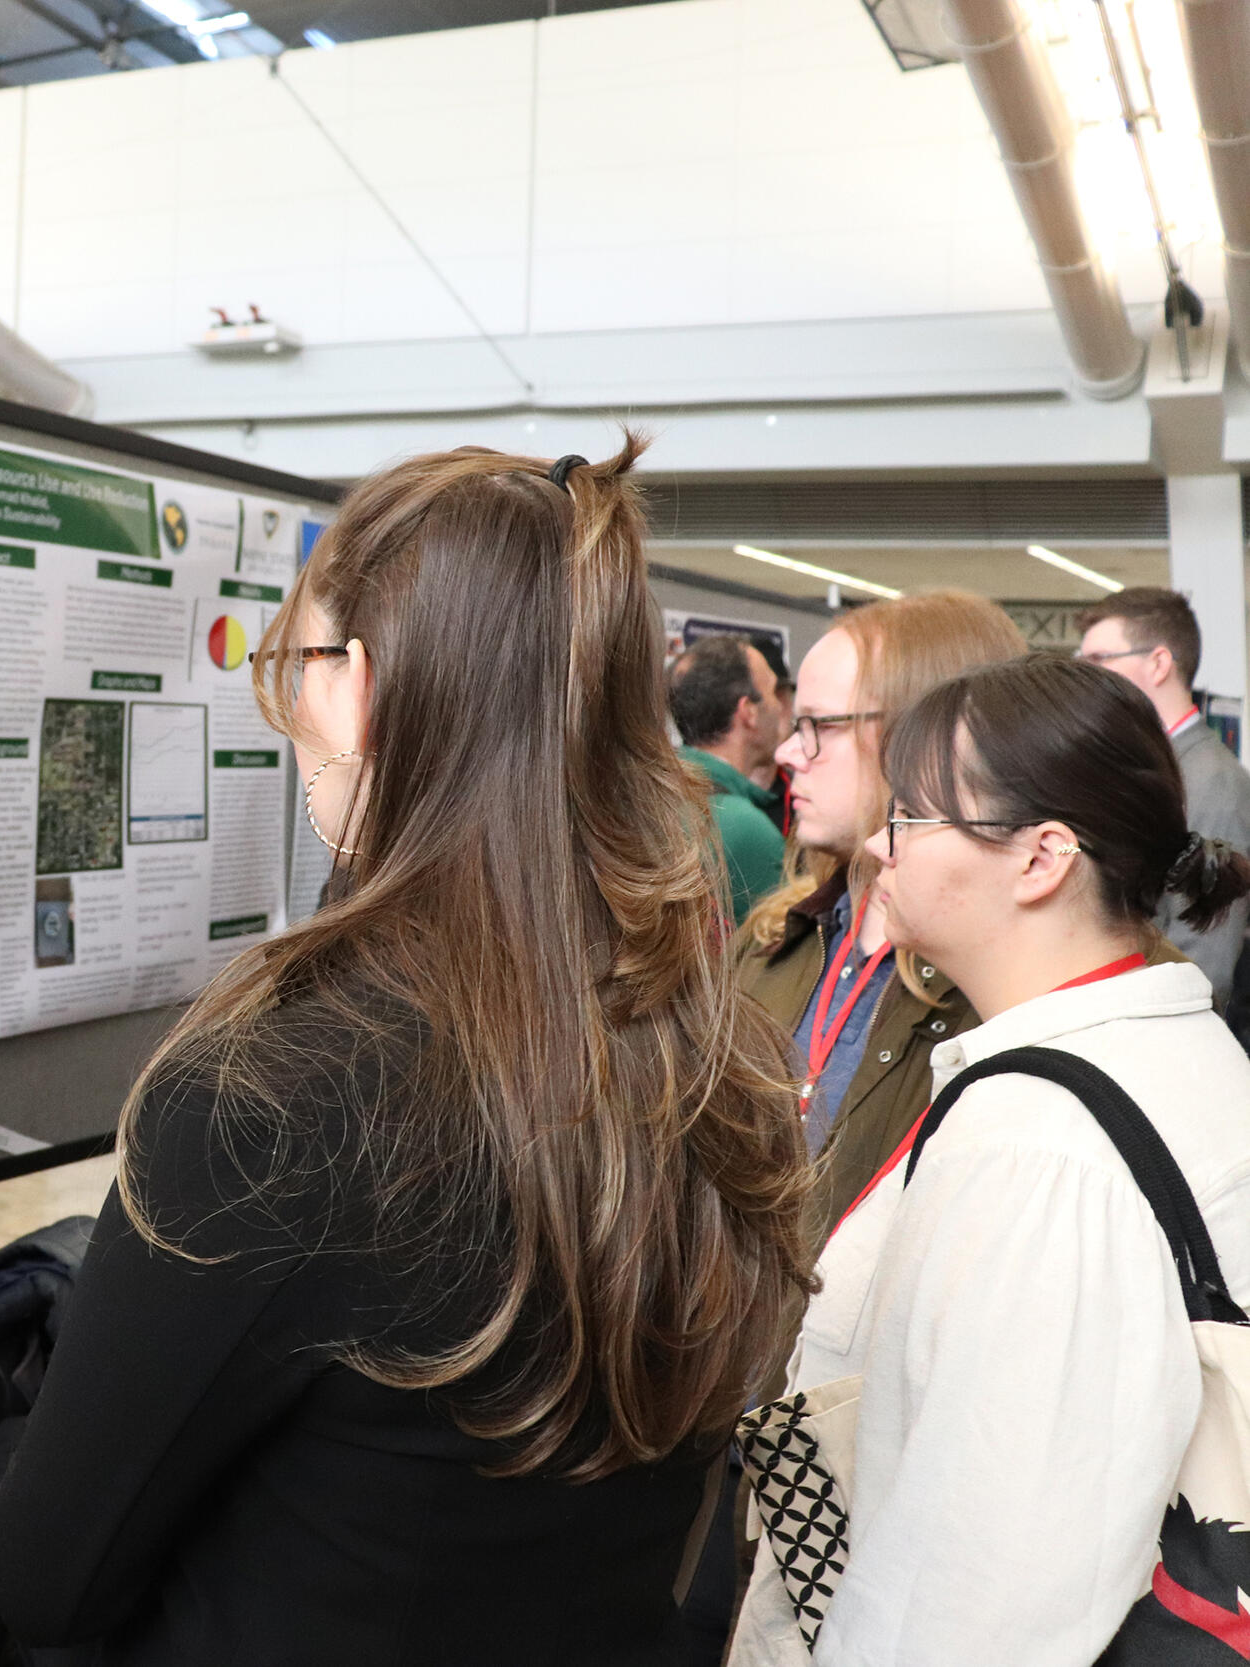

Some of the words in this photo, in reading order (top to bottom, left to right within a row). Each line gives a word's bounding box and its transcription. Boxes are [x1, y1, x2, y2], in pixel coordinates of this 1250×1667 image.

[38, 472, 60, 492] Use
[62, 480, 80, 497] and
[4, 506, 61, 530] Sustainability
